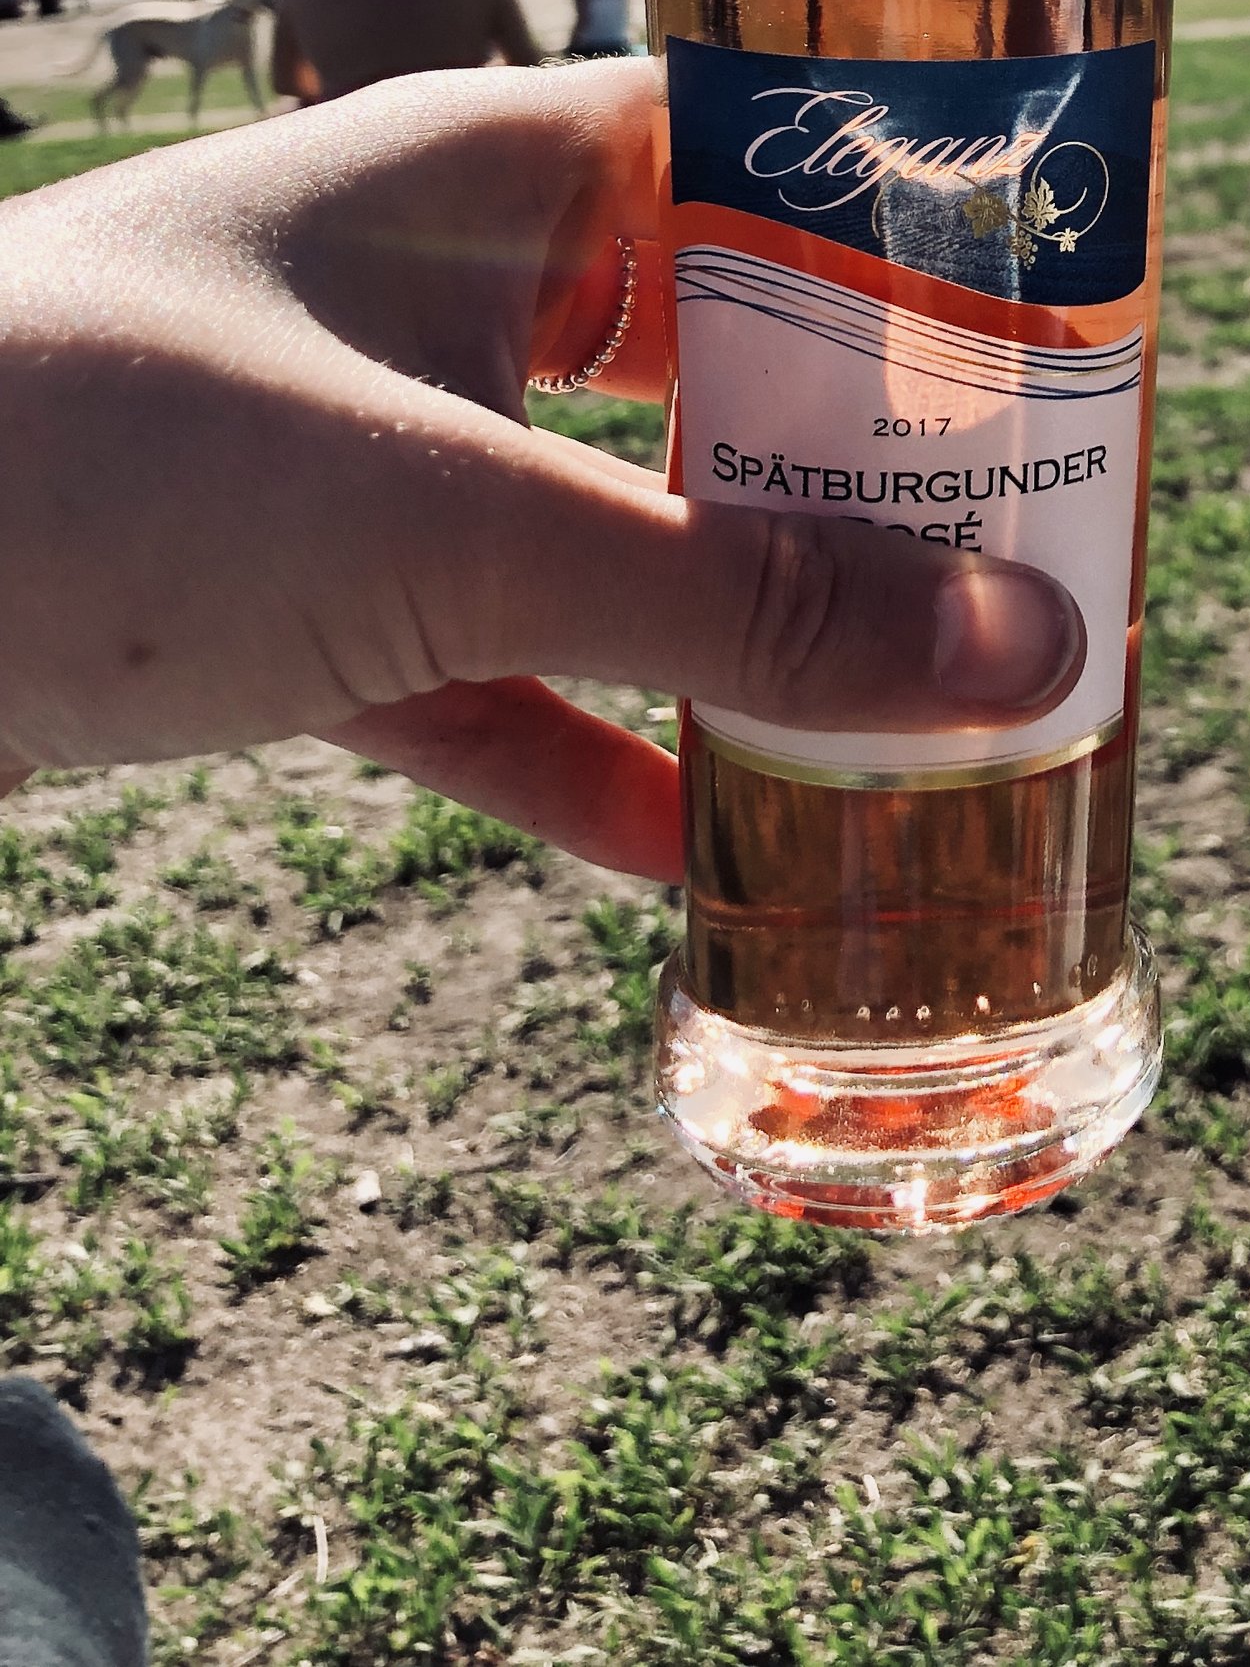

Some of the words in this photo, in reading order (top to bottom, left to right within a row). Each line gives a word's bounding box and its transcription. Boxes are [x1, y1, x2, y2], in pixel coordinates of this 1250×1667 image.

[744, 88, 1049, 211] Eleganz
[872, 417, 951, 437] 2017
[711, 442, 1107, 503] SPÄTBURGUNDER
[840, 510, 983, 553] SÉ
